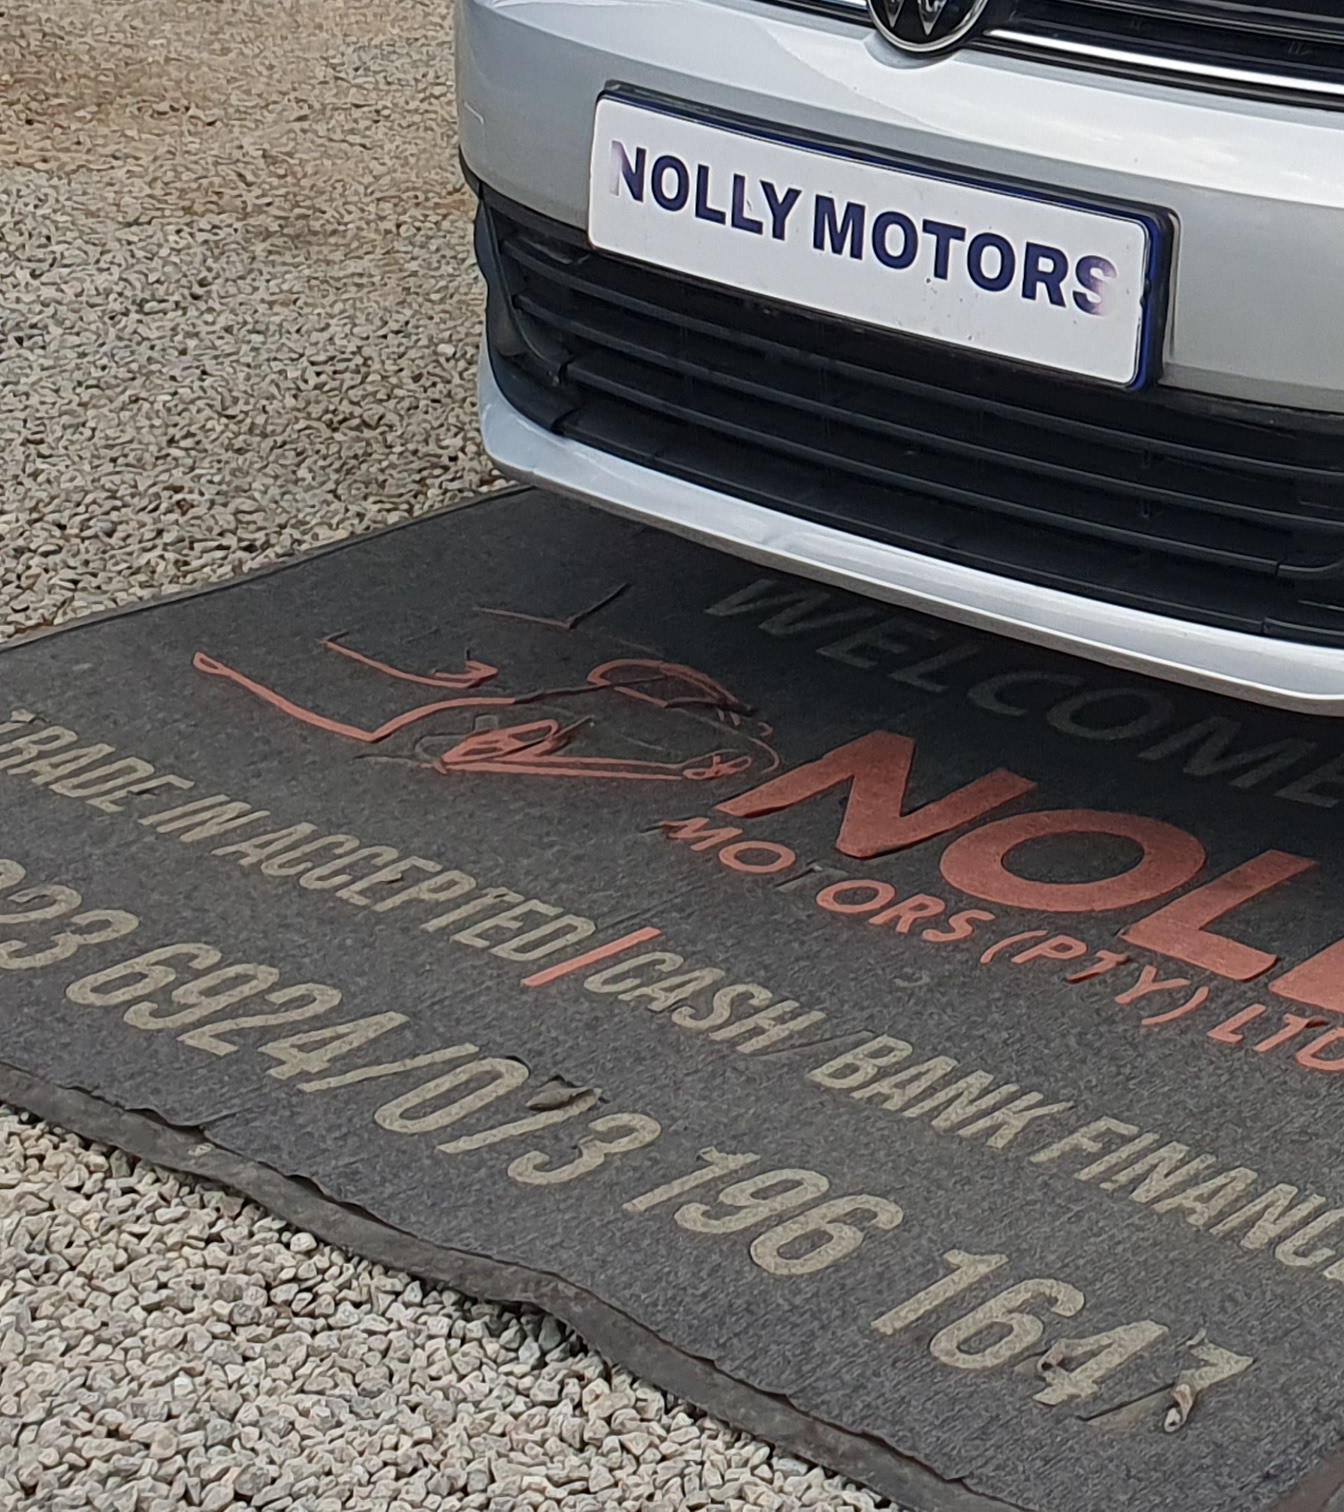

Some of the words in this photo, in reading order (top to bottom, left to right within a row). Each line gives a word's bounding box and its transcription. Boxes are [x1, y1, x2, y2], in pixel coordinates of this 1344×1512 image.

[608, 140, 802, 241] NOLLY
[812, 194, 1119, 316] MOTORS
[136, 793, 272, 844] IN
[804, 1033, 1075, 1149] BANK
[979, 929, 1210, 1026] (PTY)
[621, 1145, 905, 1276] 196
